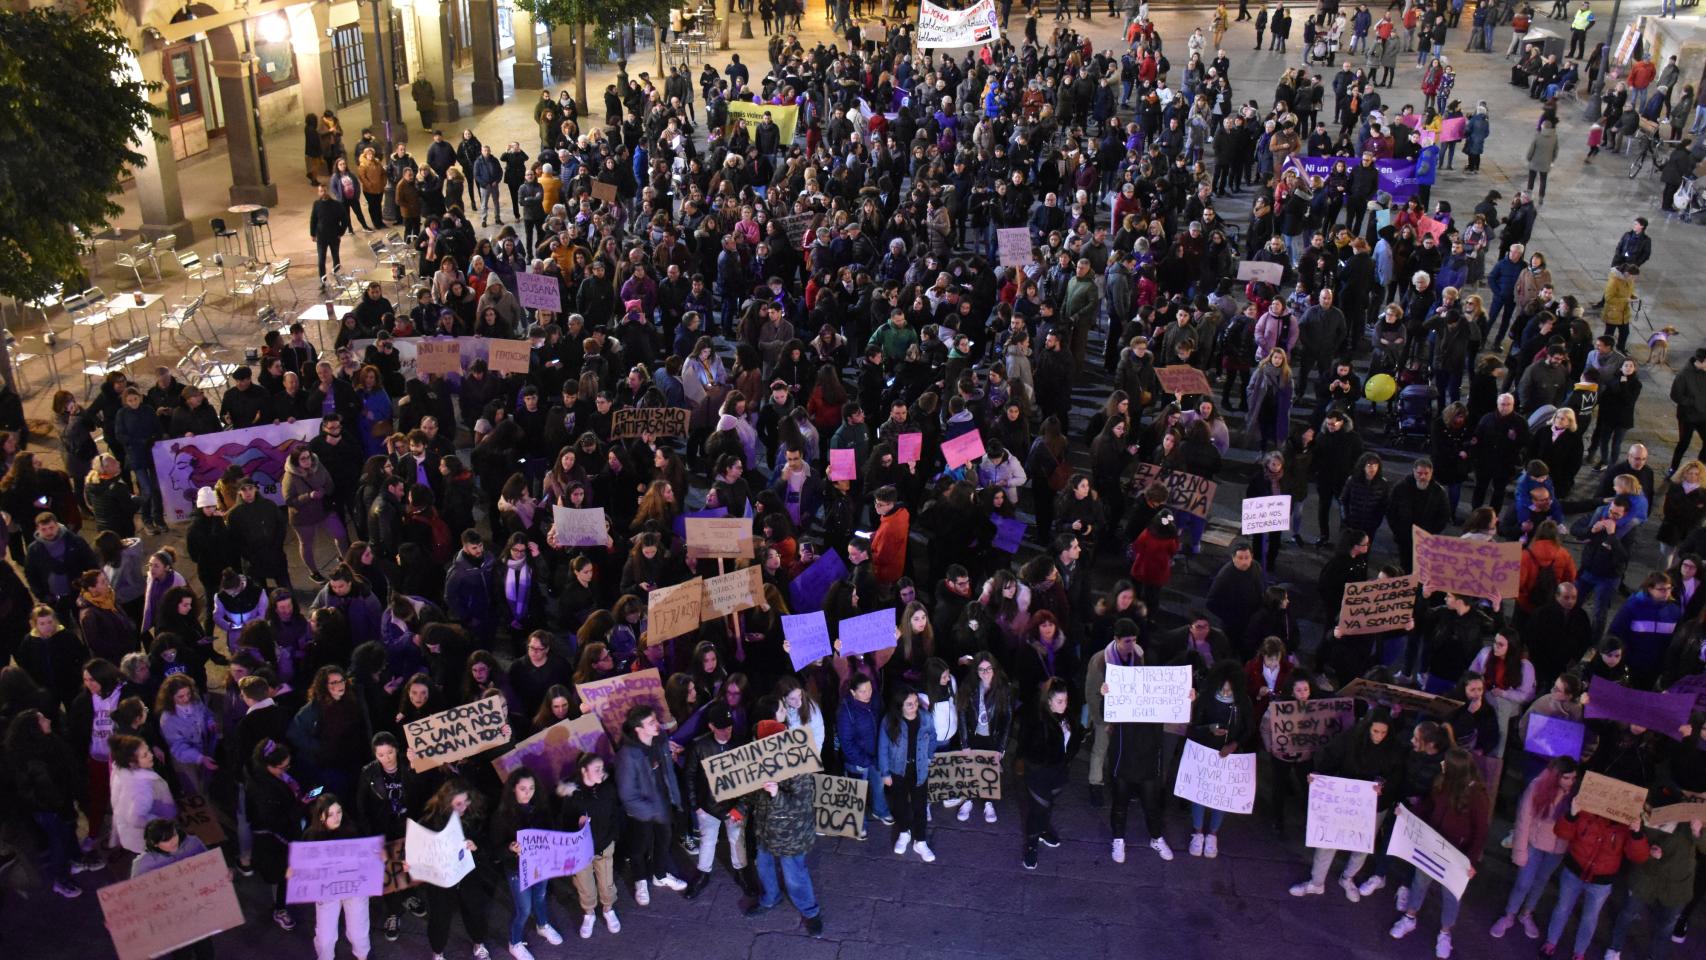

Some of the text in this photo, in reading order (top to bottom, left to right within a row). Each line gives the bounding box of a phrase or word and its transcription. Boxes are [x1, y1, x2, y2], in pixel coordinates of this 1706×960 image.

[1305, 164, 1315, 172] Ni
[520, 282, 559, 296] SUSANA
[615, 408, 686, 423] FEMINISMO
[1476, 545, 1502, 558] EL
[1347, 579, 1410, 596] QUEREMOS
[1345, 587, 1418, 605] SER LIBRES
[1344, 614, 1410, 629] YA SOMOS
[408, 700, 494, 736] SI TOCAN
[1275, 703, 1294, 717] NO
[415, 711, 503, 748] A UNA NOS
[1273, 720, 1294, 734] NO
[1296, 718, 1320, 731] SOY
[416, 739, 467, 758] TOCAN
[468, 734, 479, 746] A
[709, 729, 807, 773] FEMINISMO
[1187, 743, 1205, 763] NO
[975, 755, 998, 766] QUE
[714, 744, 822, 795] ANTIFASCISTA
[954, 767, 974, 778] NI
[836, 779, 858, 795] SIN
[955, 779, 980, 790] QUE
[820, 792, 864, 812] CUERPO
